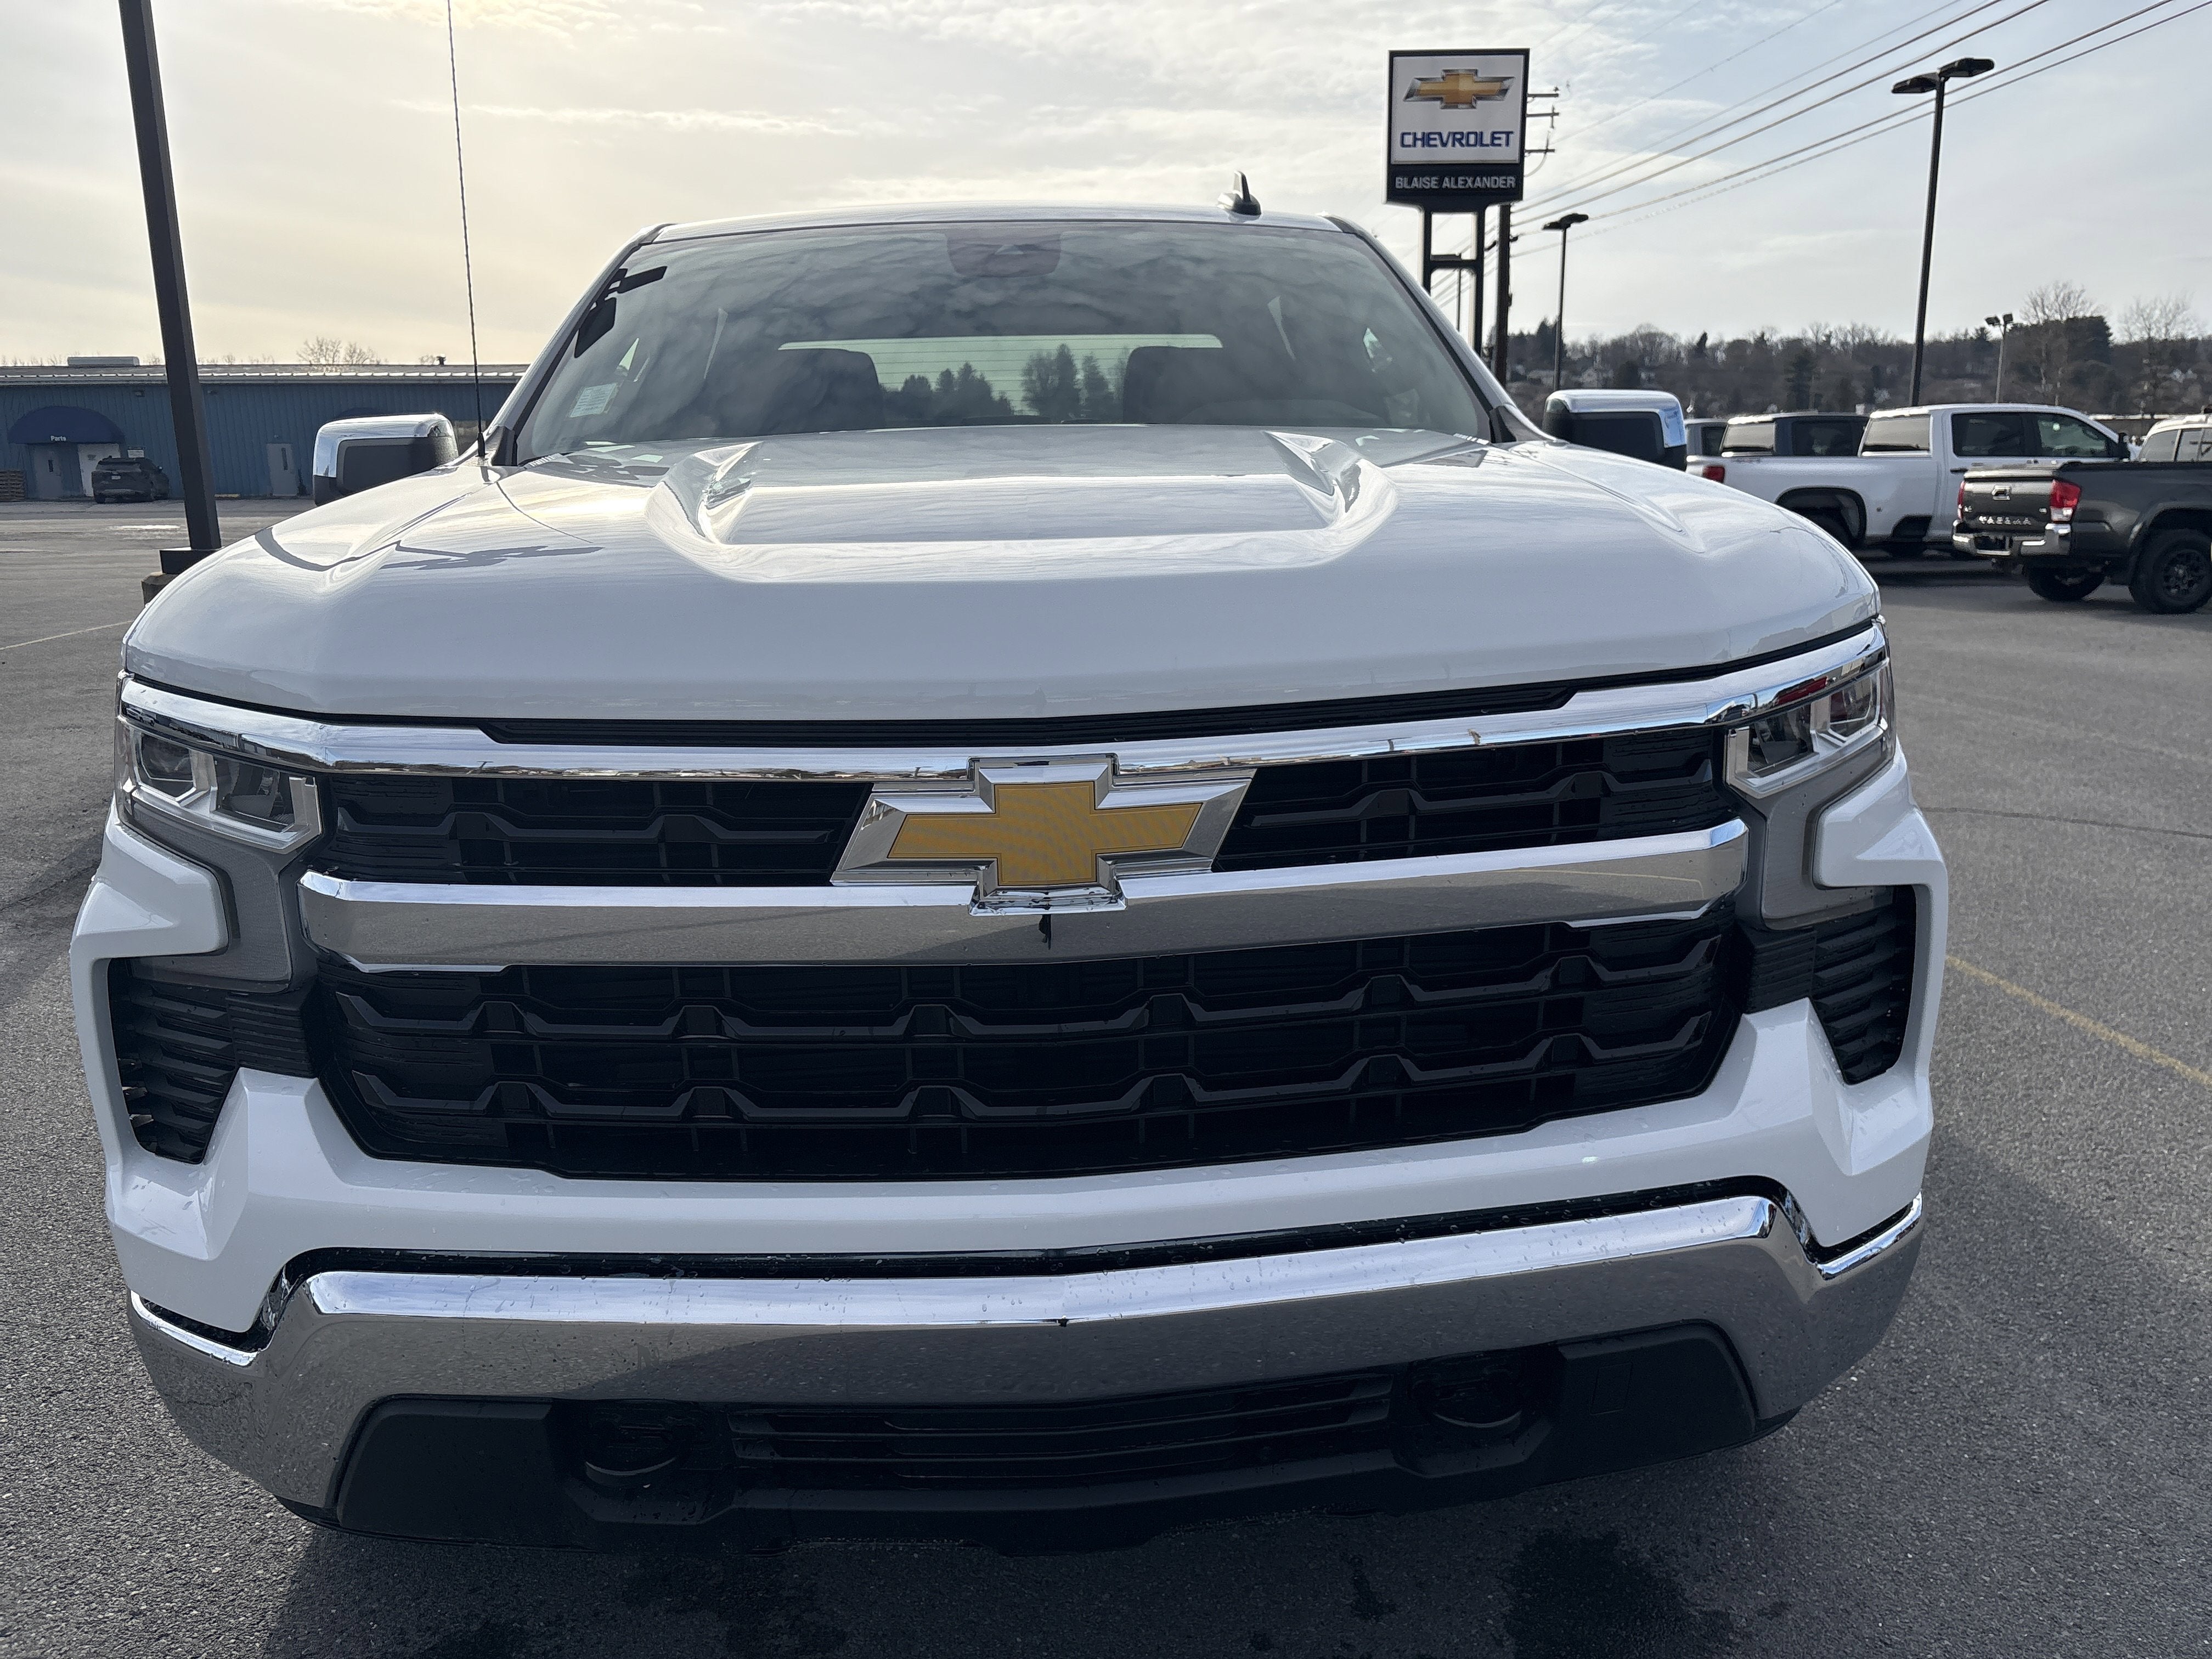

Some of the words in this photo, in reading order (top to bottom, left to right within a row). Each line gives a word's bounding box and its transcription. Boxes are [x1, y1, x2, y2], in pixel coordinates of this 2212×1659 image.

[1400, 131, 1514, 148] CHEVROLET
[1395, 176, 1440, 189] BLAISE
[1442, 176, 1516, 189] ALEXANDER
